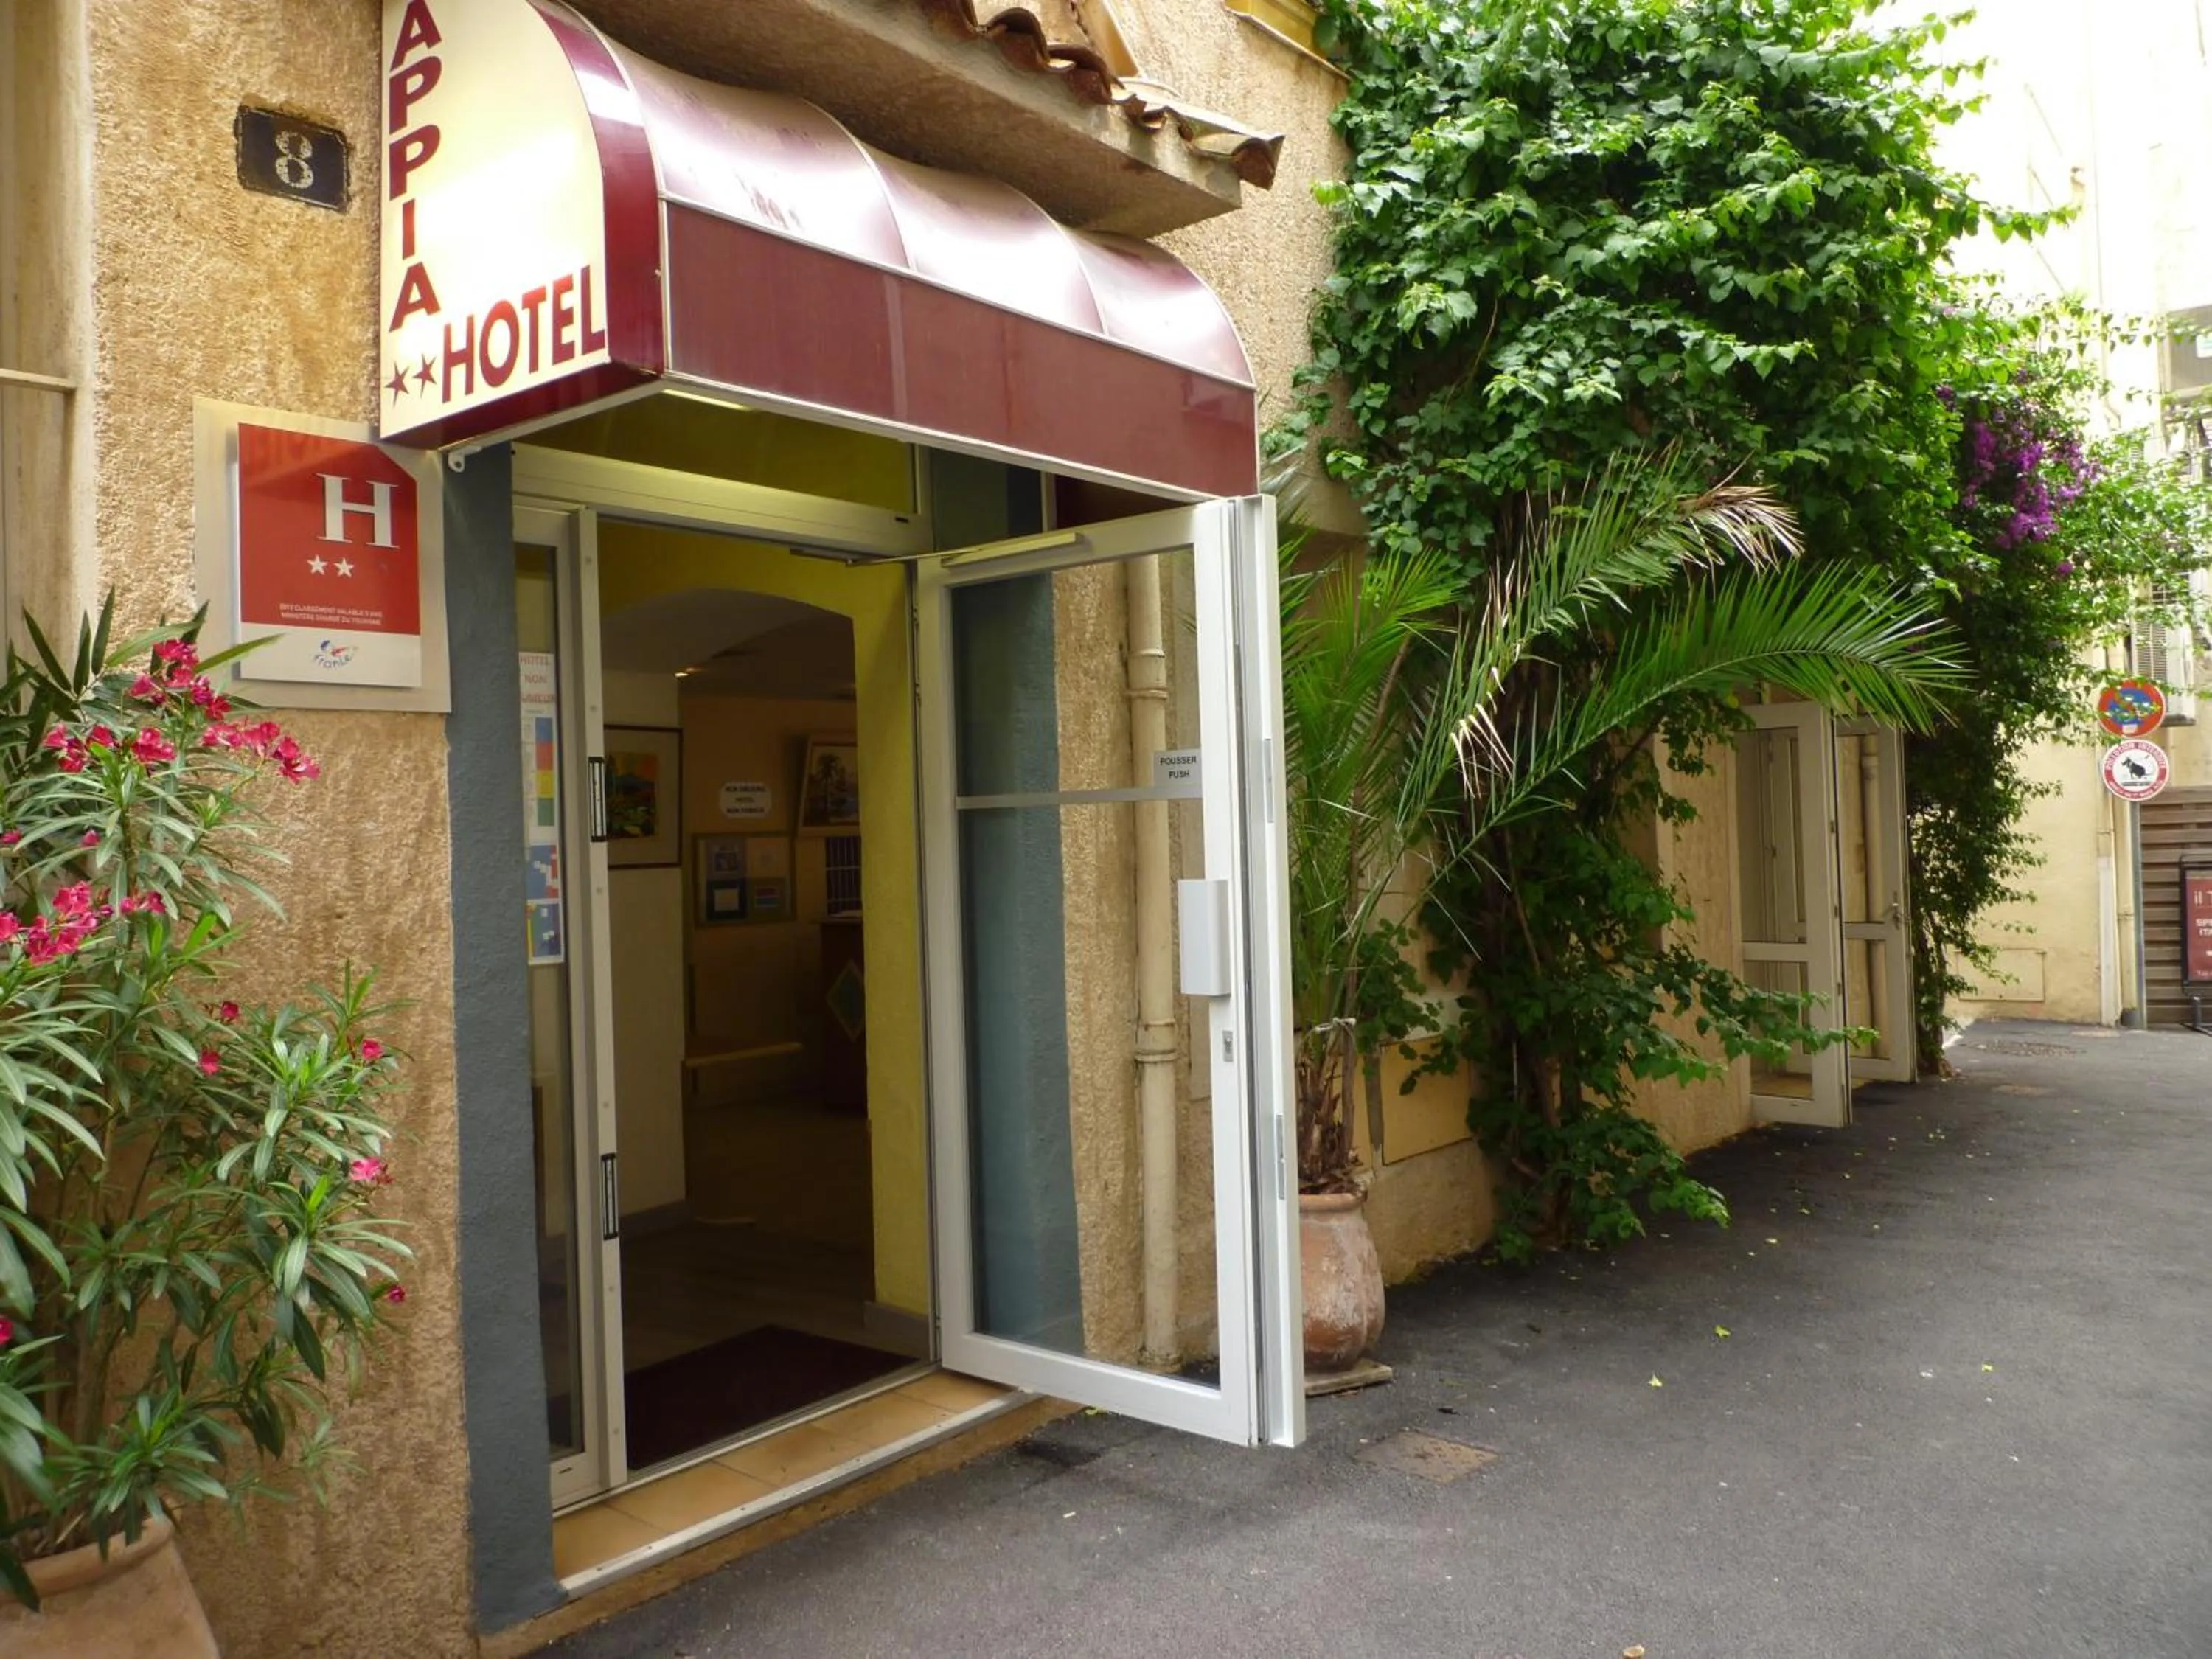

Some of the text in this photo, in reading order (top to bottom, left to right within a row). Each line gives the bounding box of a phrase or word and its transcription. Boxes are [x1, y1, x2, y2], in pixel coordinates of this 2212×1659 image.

[274, 130, 314, 189] 8
[389, 0, 442, 333] APPIA
[442, 264, 606, 403] HOTEL
[315, 472, 400, 549] H
[1160, 755, 1197, 766] POUSSER
[1169, 769, 1190, 779] PUSH
